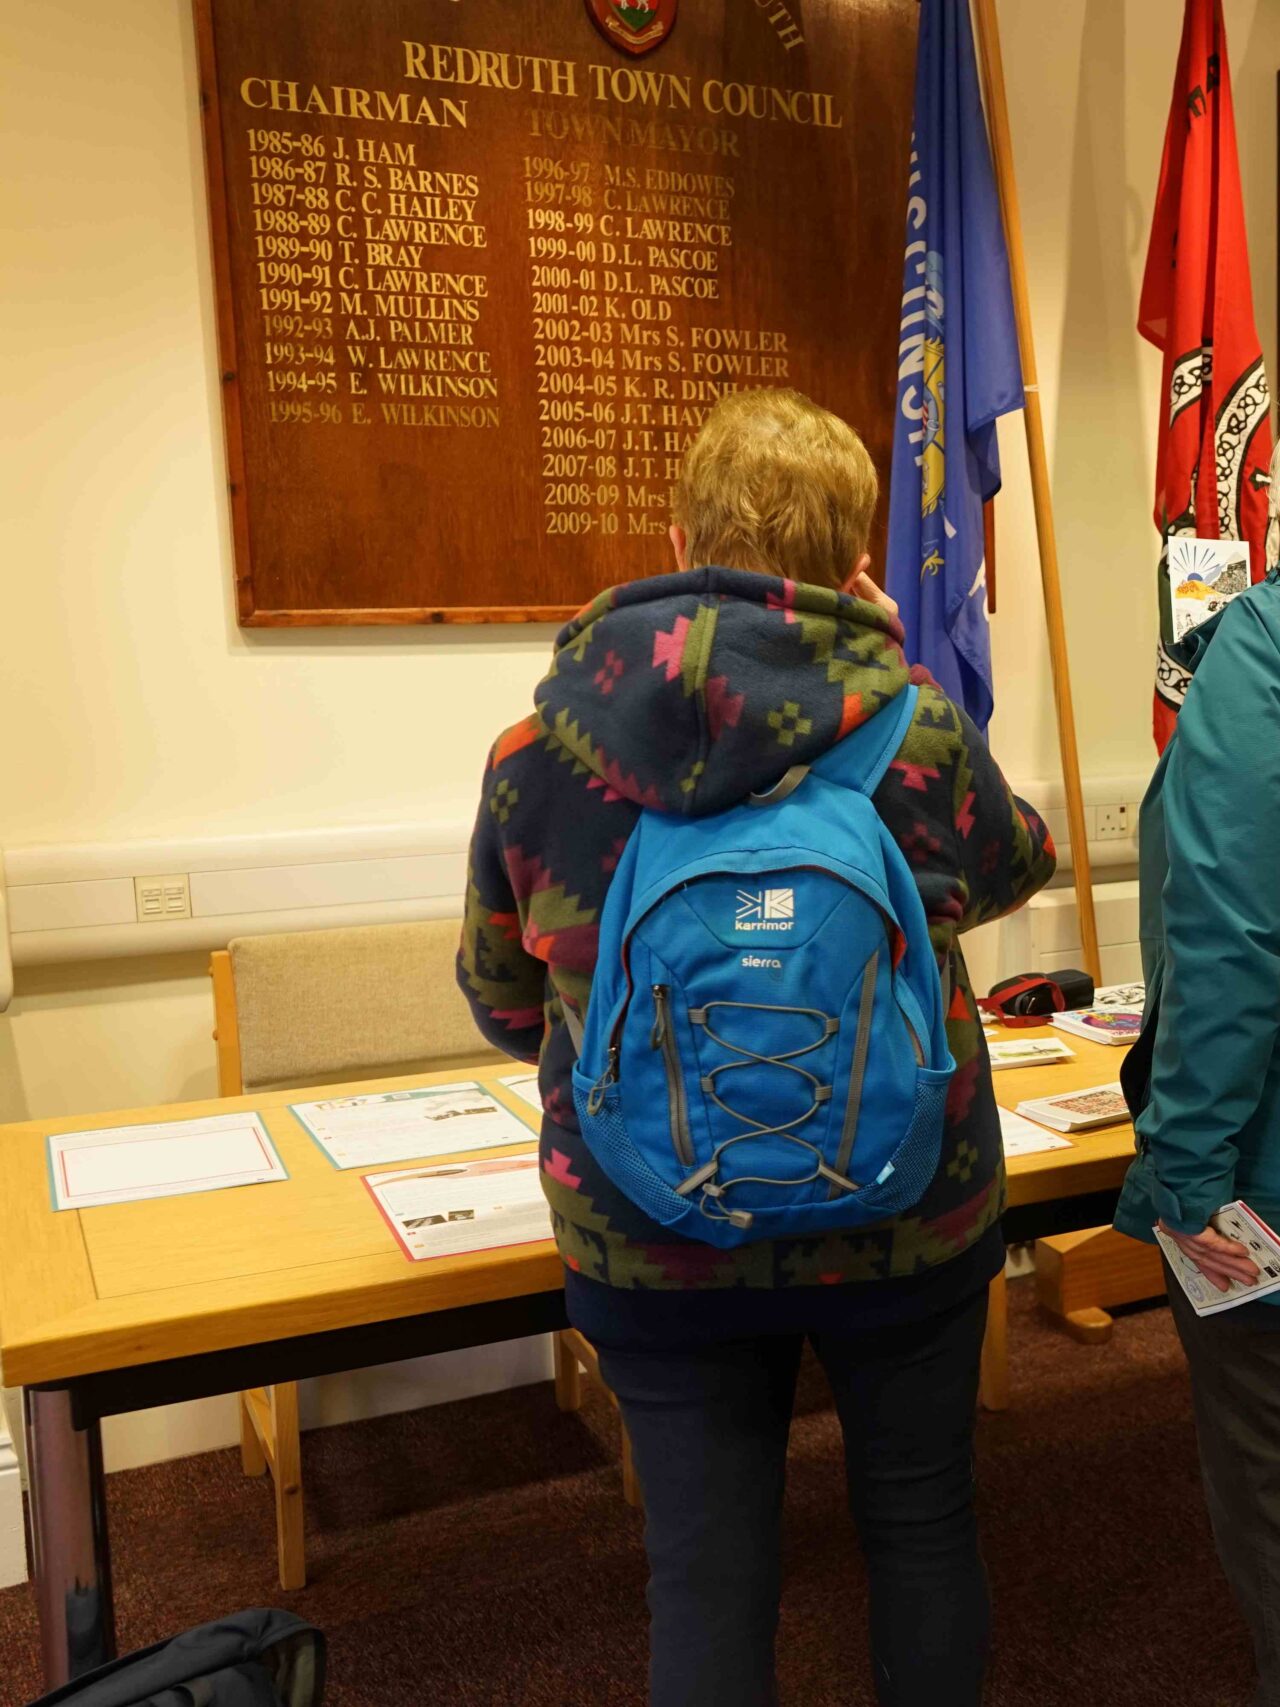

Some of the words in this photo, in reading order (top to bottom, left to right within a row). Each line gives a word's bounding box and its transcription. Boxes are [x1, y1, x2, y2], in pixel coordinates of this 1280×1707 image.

[402, 40, 579, 96] REDRUTH
[588, 63, 692, 110] TOWN
[702, 79, 843, 128] COUNCIL
[240, 77, 469, 128] CHAIRMAN
[247, 128, 326, 158] 1985-86
[333, 136, 350, 160] J.
[356, 139, 416, 167] HAM
[525, 107, 621, 145] TOWN
[630, 117, 740, 158] MAYOR
[249, 155, 327, 184] 1986-87
[335, 163, 357, 187] R.
[364, 166, 382, 189] S.
[388, 168, 479, 197] BARNES
[523, 156, 590, 183] 1996-97
[604, 164, 641, 189] M.S.
[646, 169, 735, 198] EDDOWES
[251, 182, 329, 210] 1987-88
[335, 189, 356, 212] C.
[361, 191, 382, 214] C.
[388, 193, 476, 223] HAILEY
[525, 181, 592, 207] 1997-98
[604, 189, 622, 211] C.
[626, 191, 731, 221] LAWRENCE
[253, 208, 331, 235] 1988-89
[337, 215, 358, 238] C.
[364, 217, 487, 248] LAWRENCE
[527, 208, 594, 234] 1998-99
[600, 215, 620, 237] C.
[626, 216, 732, 247] LAWRENCE
[254, 234, 333, 262] 1989-90
[339, 241, 359, 264] T.
[366, 242, 424, 268] BRAY
[528, 237, 596, 262] 1999-00
[601, 242, 642, 267] D.L.
[648, 246, 718, 272] PASCOE
[257, 262, 333, 288] 1990-91
[338, 266, 359, 289] C.
[366, 268, 489, 298] LAWRENCE
[531, 265, 596, 291] 2000-01
[604, 271, 644, 295] D.L.
[650, 274, 719, 300] PASCOE
[259, 288, 333, 313] 1991-92
[339, 292, 368, 315] M.
[374, 294, 480, 322] MULLINS
[532, 292, 598, 317] 2001-02
[605, 297, 626, 320] K.
[631, 298, 672, 322] OLD
[263, 314, 333, 340] 1992-93
[345, 319, 381, 342] A.J.
[389, 320, 474, 346] PALMER
[532, 317, 613, 343] 2002-03
[619, 323, 661, 347] Mrs
[666, 325, 684, 348] S.
[691, 327, 788, 353] FOWLER
[264, 342, 336, 367] 1993-94
[347, 345, 374, 368] W.
[379, 346, 492, 374] LAWRENCE
[535, 344, 615, 369] 2003-04
[621, 350, 662, 372] Mrs
[668, 351, 686, 373] S.
[692, 353, 789, 378] FOWLER
[267, 370, 338, 394] 1994-95
[350, 372, 368, 395] E.
[377, 373, 498, 399] WILKINSON
[537, 371, 617, 396] 2004-05
[623, 376, 647, 399] K.
[653, 378, 675, 399] R.
[681, 379, 776, 400] DINH
[270, 400, 342, 424] 1995-96
[352, 402, 372, 425] E.
[381, 402, 500, 428] WILKINSON
[539, 399, 616, 423] 2005-06
[620, 403, 656, 425] J.T.
[662, 405, 712, 427] HAY
[541, 426, 616, 450] 2006-07
[622, 430, 658, 452] J.T.
[543, 454, 617, 478] 2007-08
[623, 457, 658, 479] J.T.
[544, 483, 620, 506] 2008-09
[627, 485, 665, 507] Mrs
[546, 512, 619, 535] 2009-10
[627, 513, 666, 535] Mrs
[735, 920, 794, 931] karrimor
[741, 955, 782, 968] sierra
